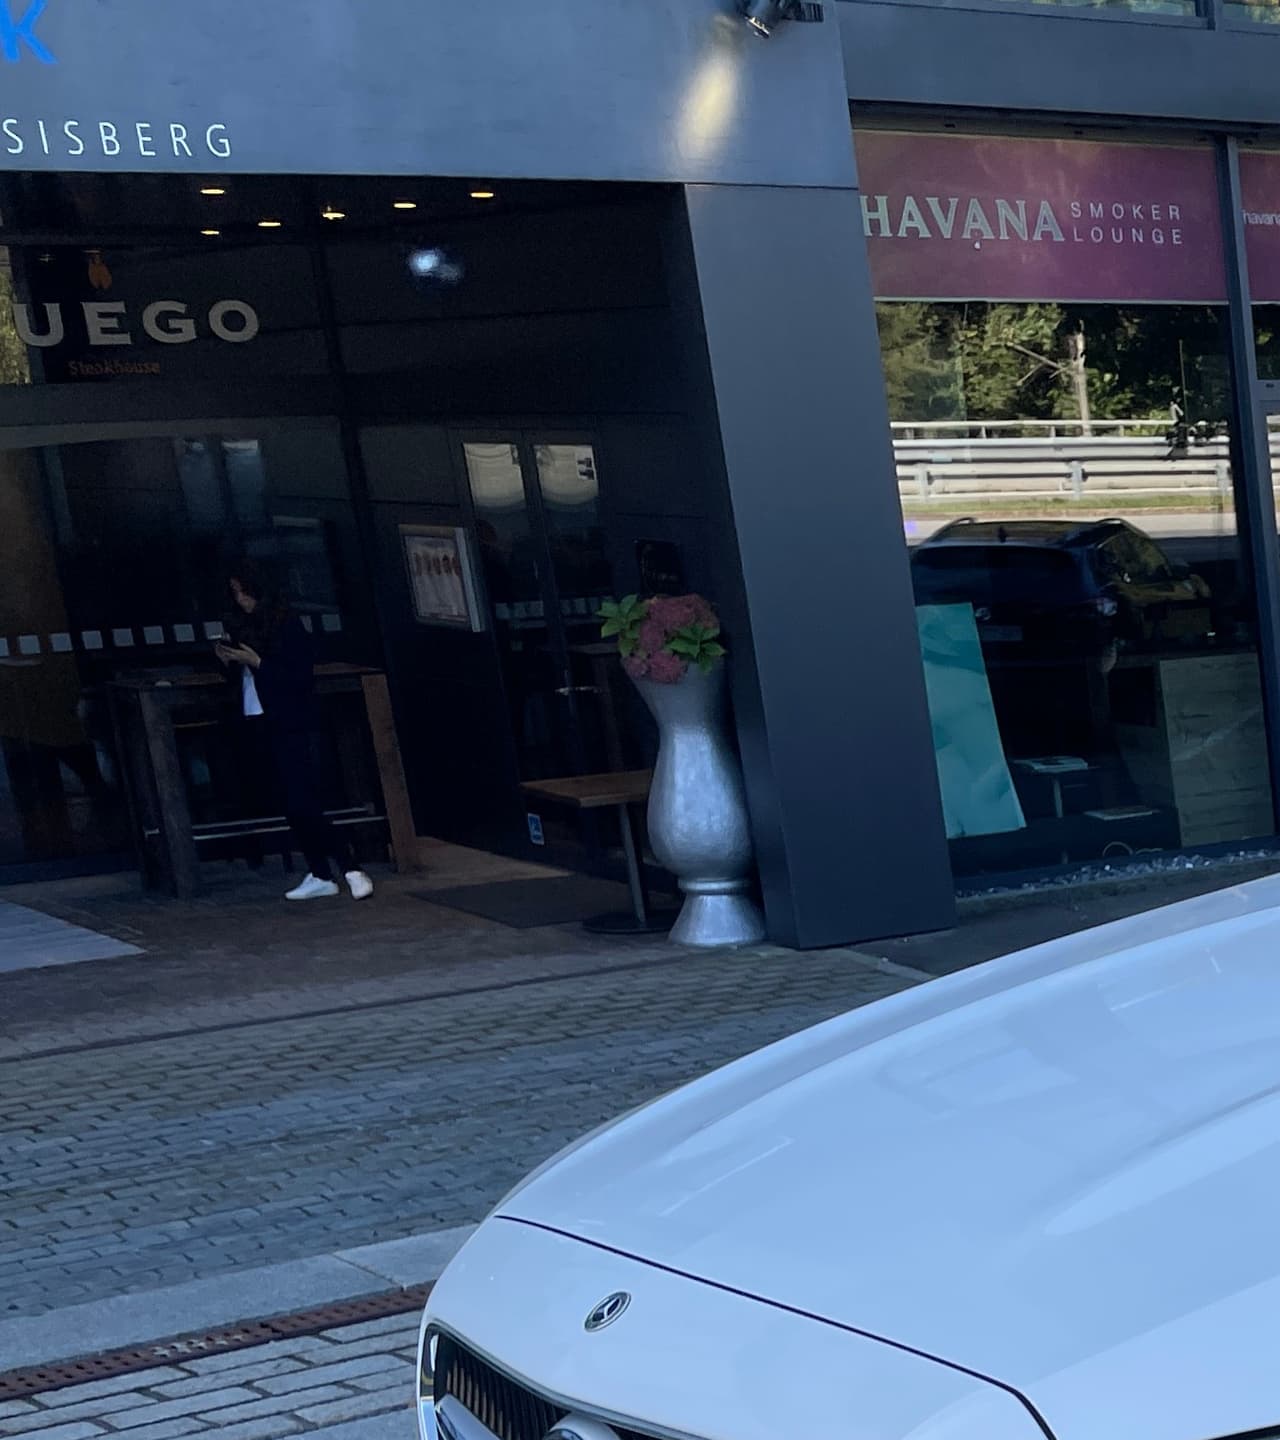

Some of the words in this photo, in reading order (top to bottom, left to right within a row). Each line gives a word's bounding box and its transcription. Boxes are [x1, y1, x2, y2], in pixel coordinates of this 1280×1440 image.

[2, 119, 231, 157] SISBERG
[859, 195, 1065, 242] HAVANA
[1070, 201, 1182, 221] SMOKER
[1073, 226, 1183, 245] LOUNGE
[13, 299, 260, 347] UEGO
